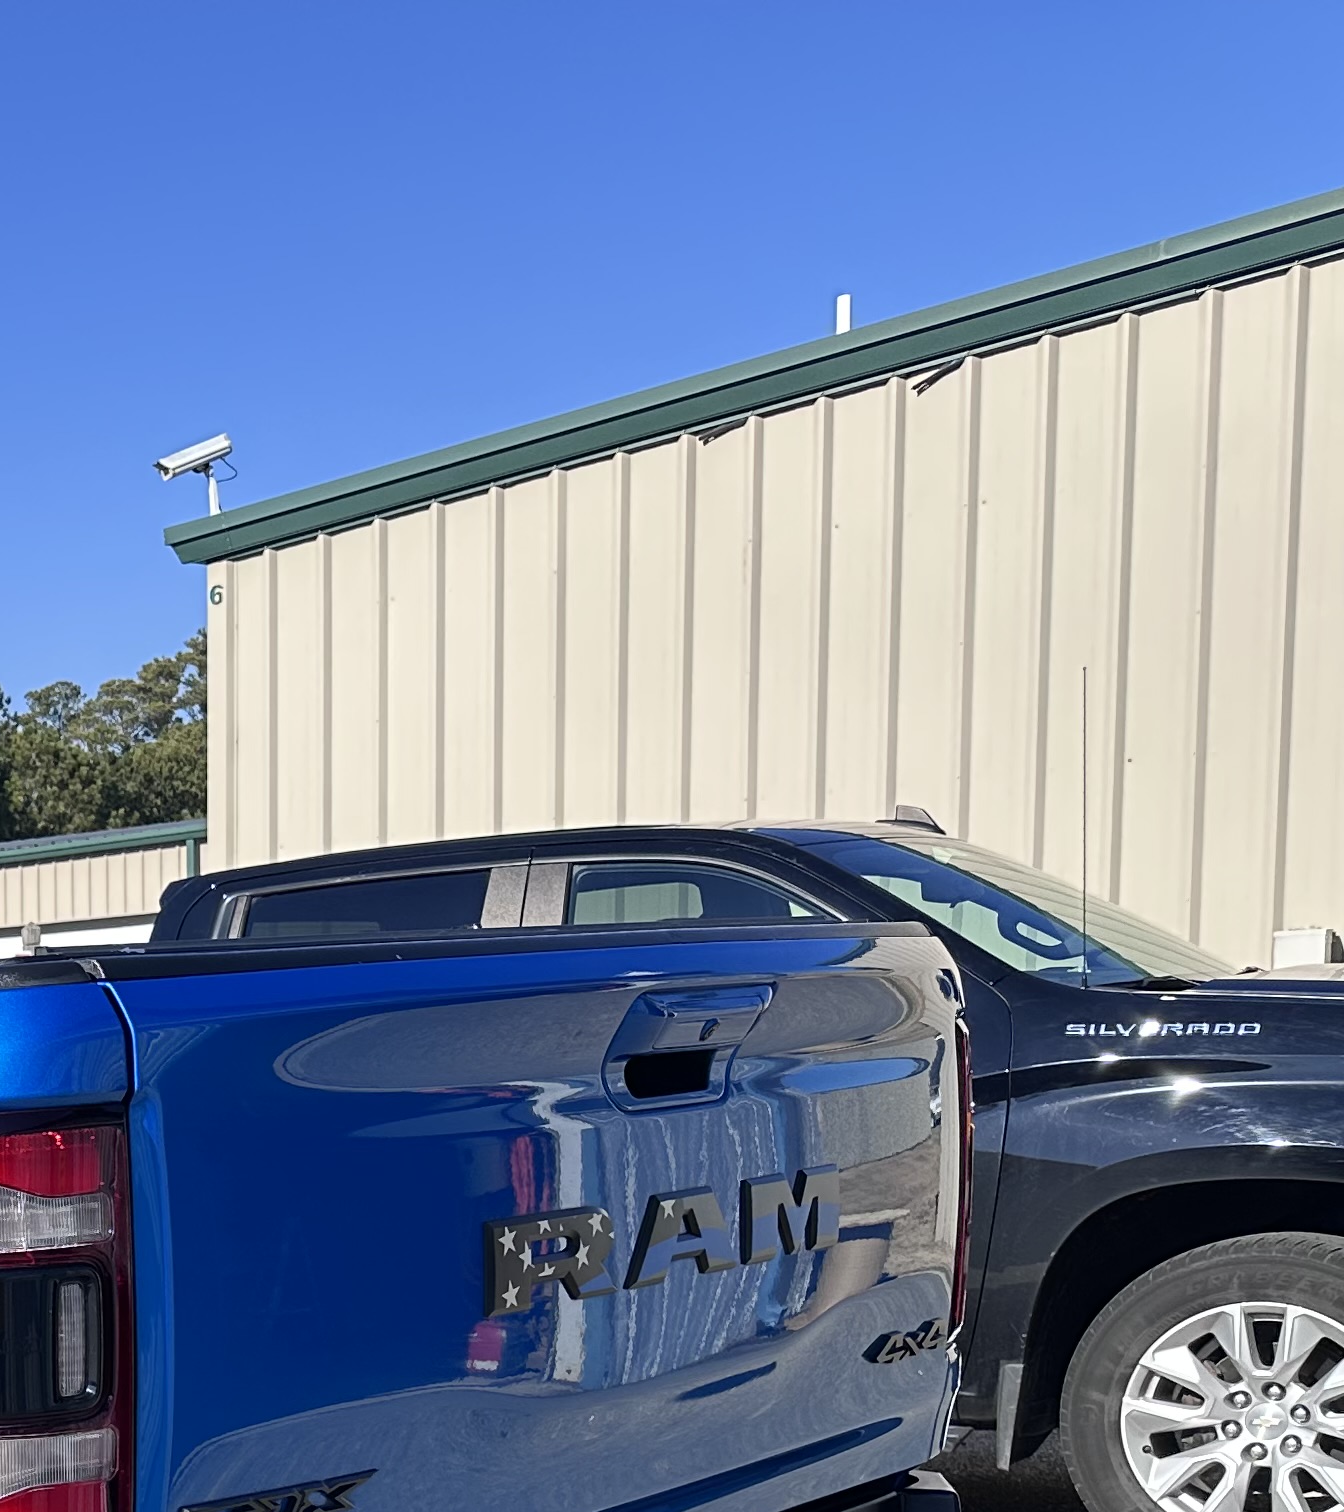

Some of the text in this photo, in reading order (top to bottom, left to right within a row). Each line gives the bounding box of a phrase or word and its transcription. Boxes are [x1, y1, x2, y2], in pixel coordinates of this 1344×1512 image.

[209, 584, 224, 605] 6
[1065, 1021, 1262, 1037] SILVRADO
[484, 1163, 839, 1317] RAM
